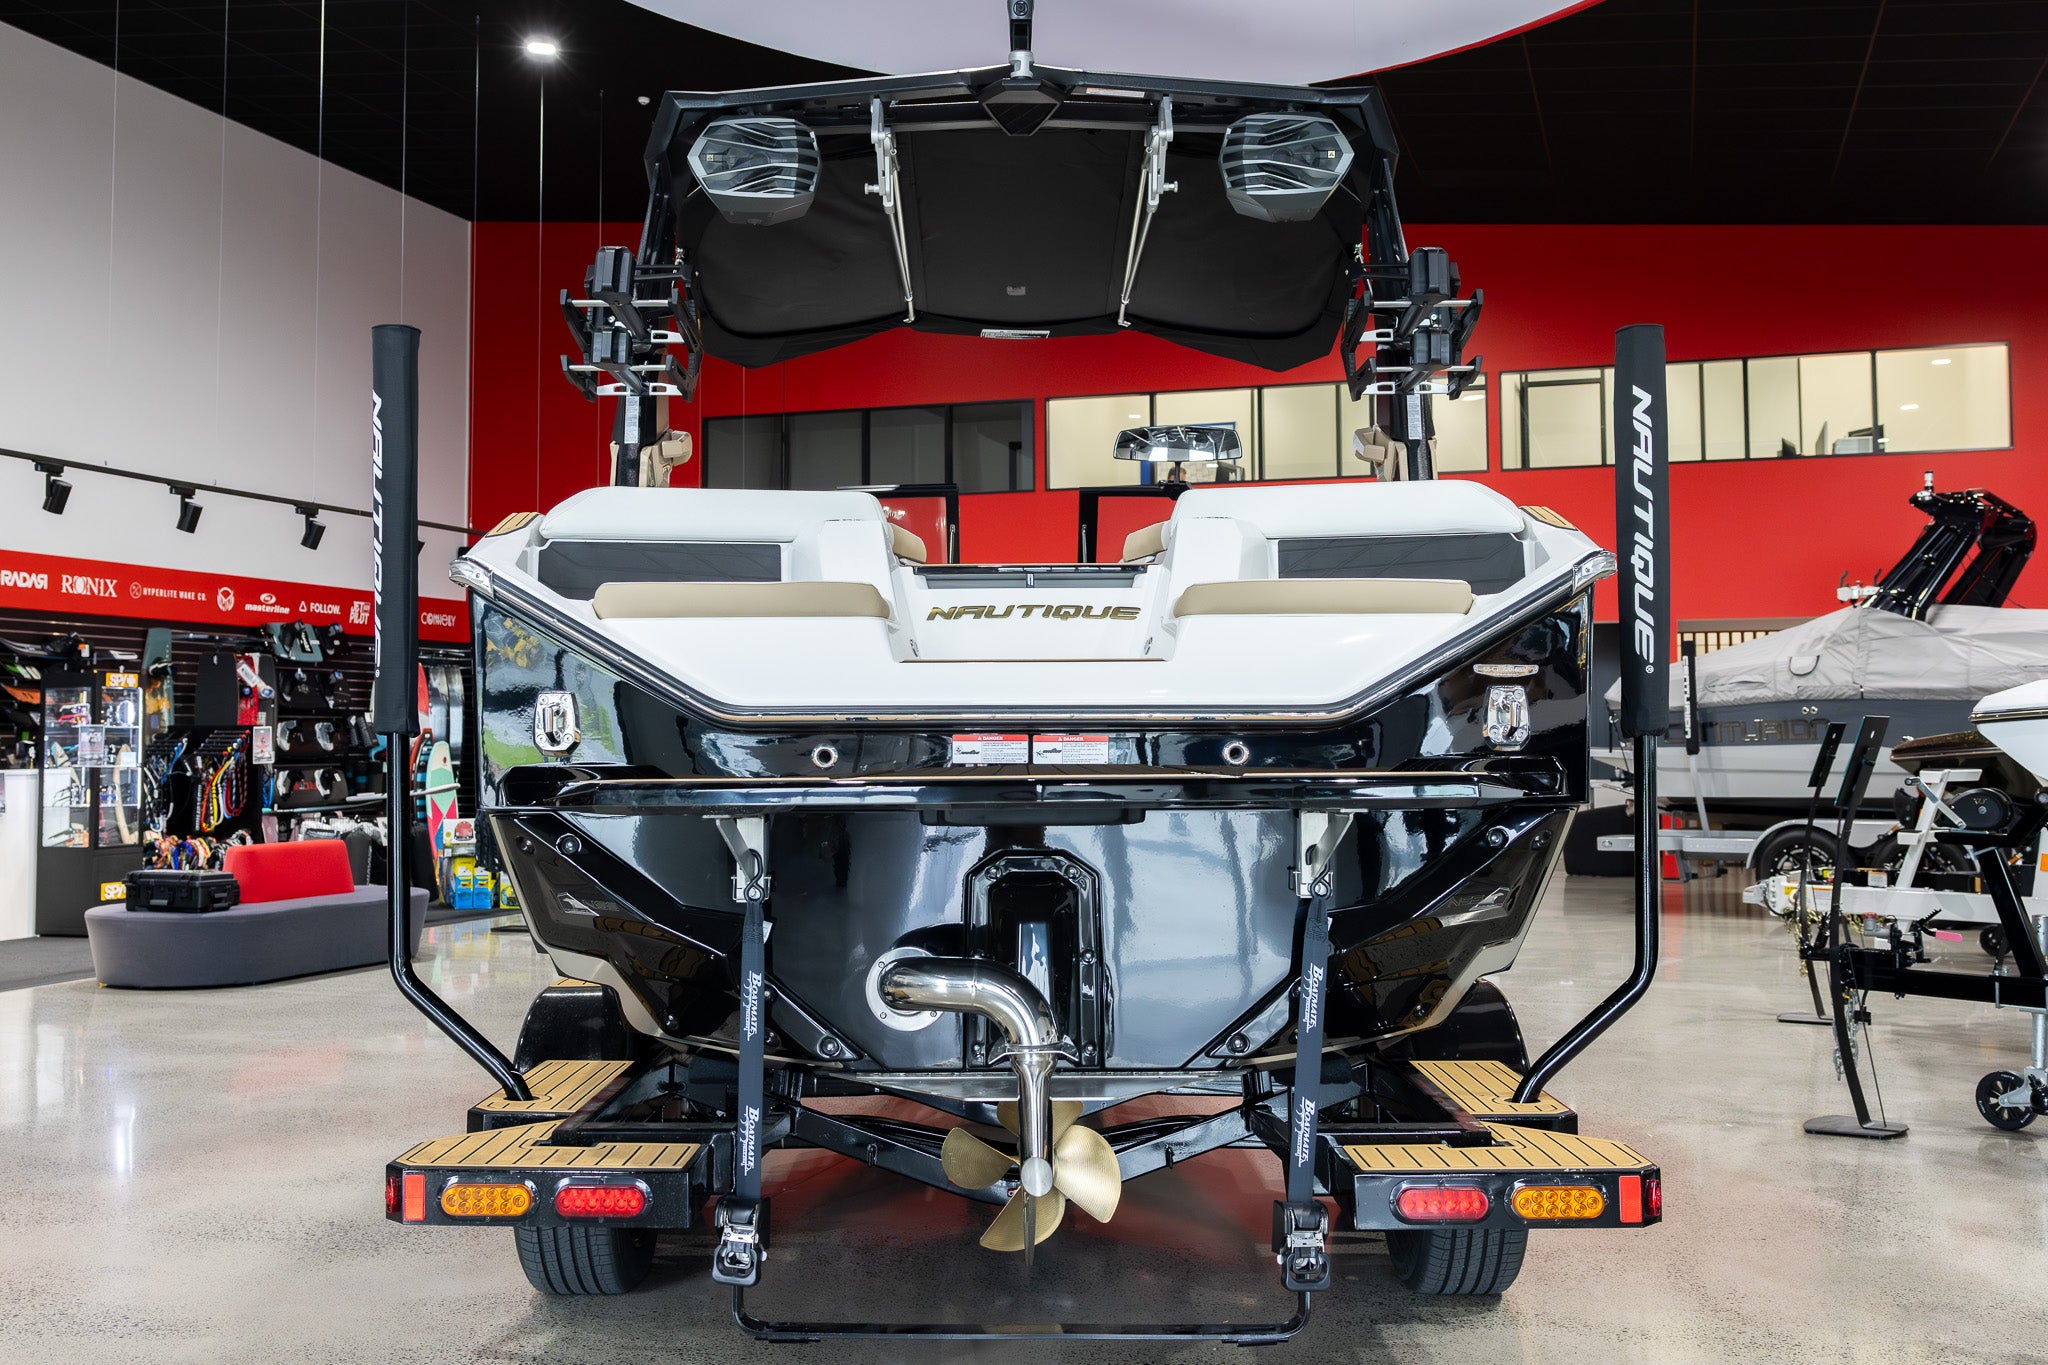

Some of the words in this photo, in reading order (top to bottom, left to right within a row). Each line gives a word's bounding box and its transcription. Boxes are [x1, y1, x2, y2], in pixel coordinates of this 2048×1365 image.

[1, 570, 48, 590] RADAR
[61, 574, 118, 598] RONIX
[244, 603, 290, 615] masterline
[926, 604, 1141, 621] NAUTIQUE
[349, 611, 369, 625] PILOT
